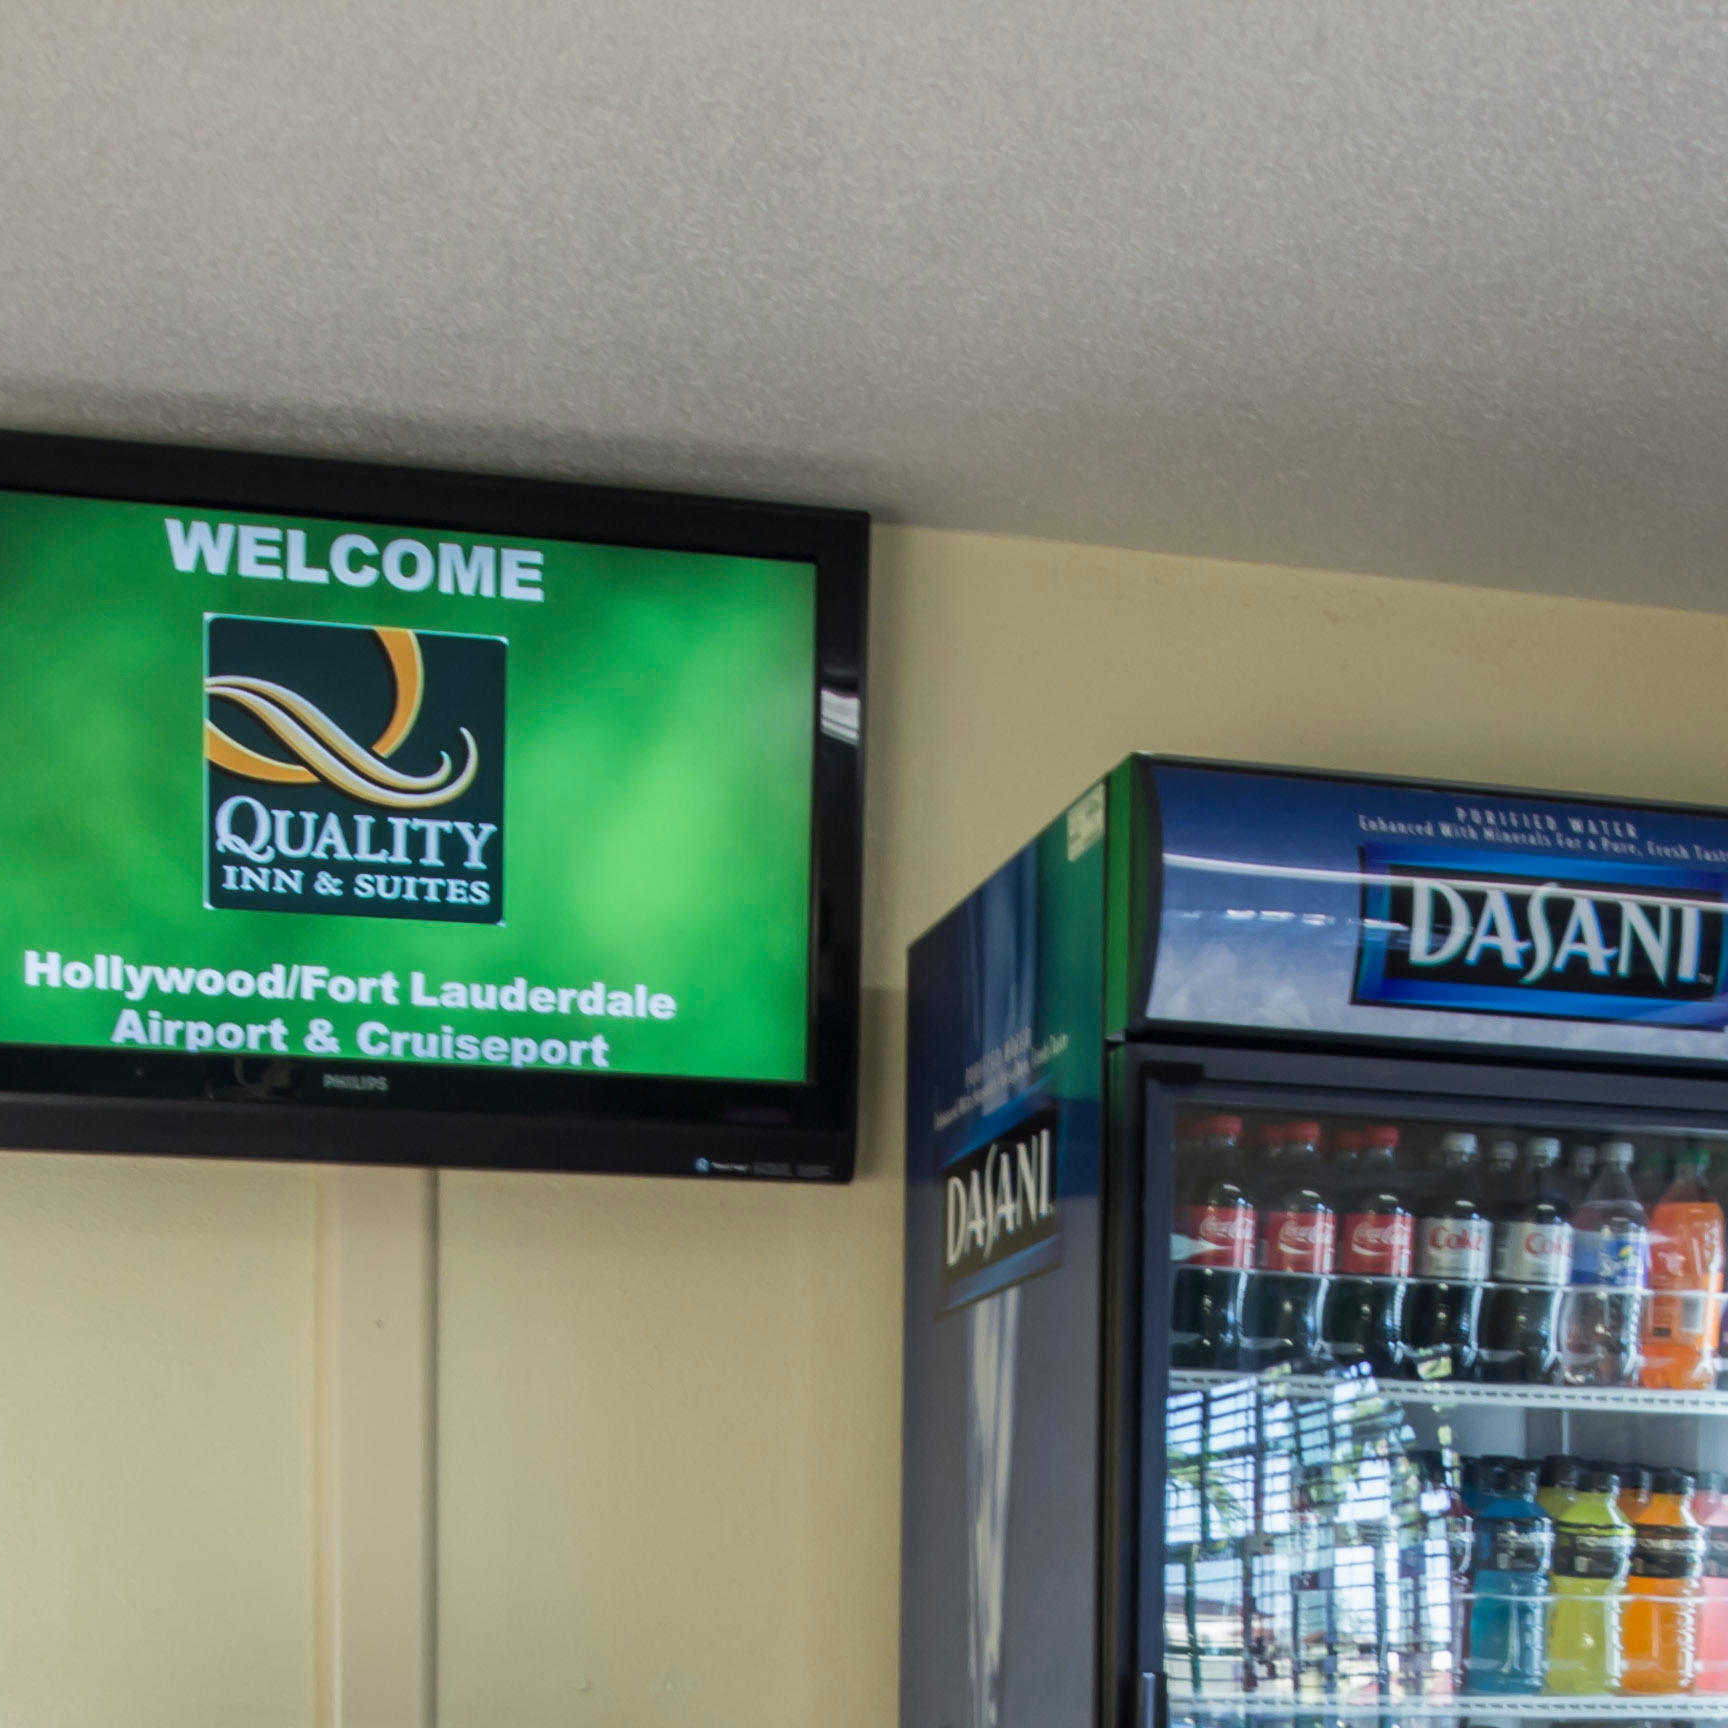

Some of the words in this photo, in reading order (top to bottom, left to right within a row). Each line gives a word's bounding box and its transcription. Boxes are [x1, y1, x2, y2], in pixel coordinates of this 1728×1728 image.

[165, 518, 545, 603] WELCOME
[214, 795, 498, 871] QUALITY
[222, 865, 303, 896] INN
[313, 872, 343, 898] &
[352, 873, 491, 906] SUITES
[1408, 878, 1703, 988] DASANI
[24, 950, 399, 1005] Hollywood/Fort
[411, 971, 677, 1021] Lauderdale
[111, 1008, 289, 1053] Airport
[303, 1019, 340, 1054] &
[356, 1022, 611, 1069] Cruiseport
[947, 1127, 1051, 1269] DASANI
